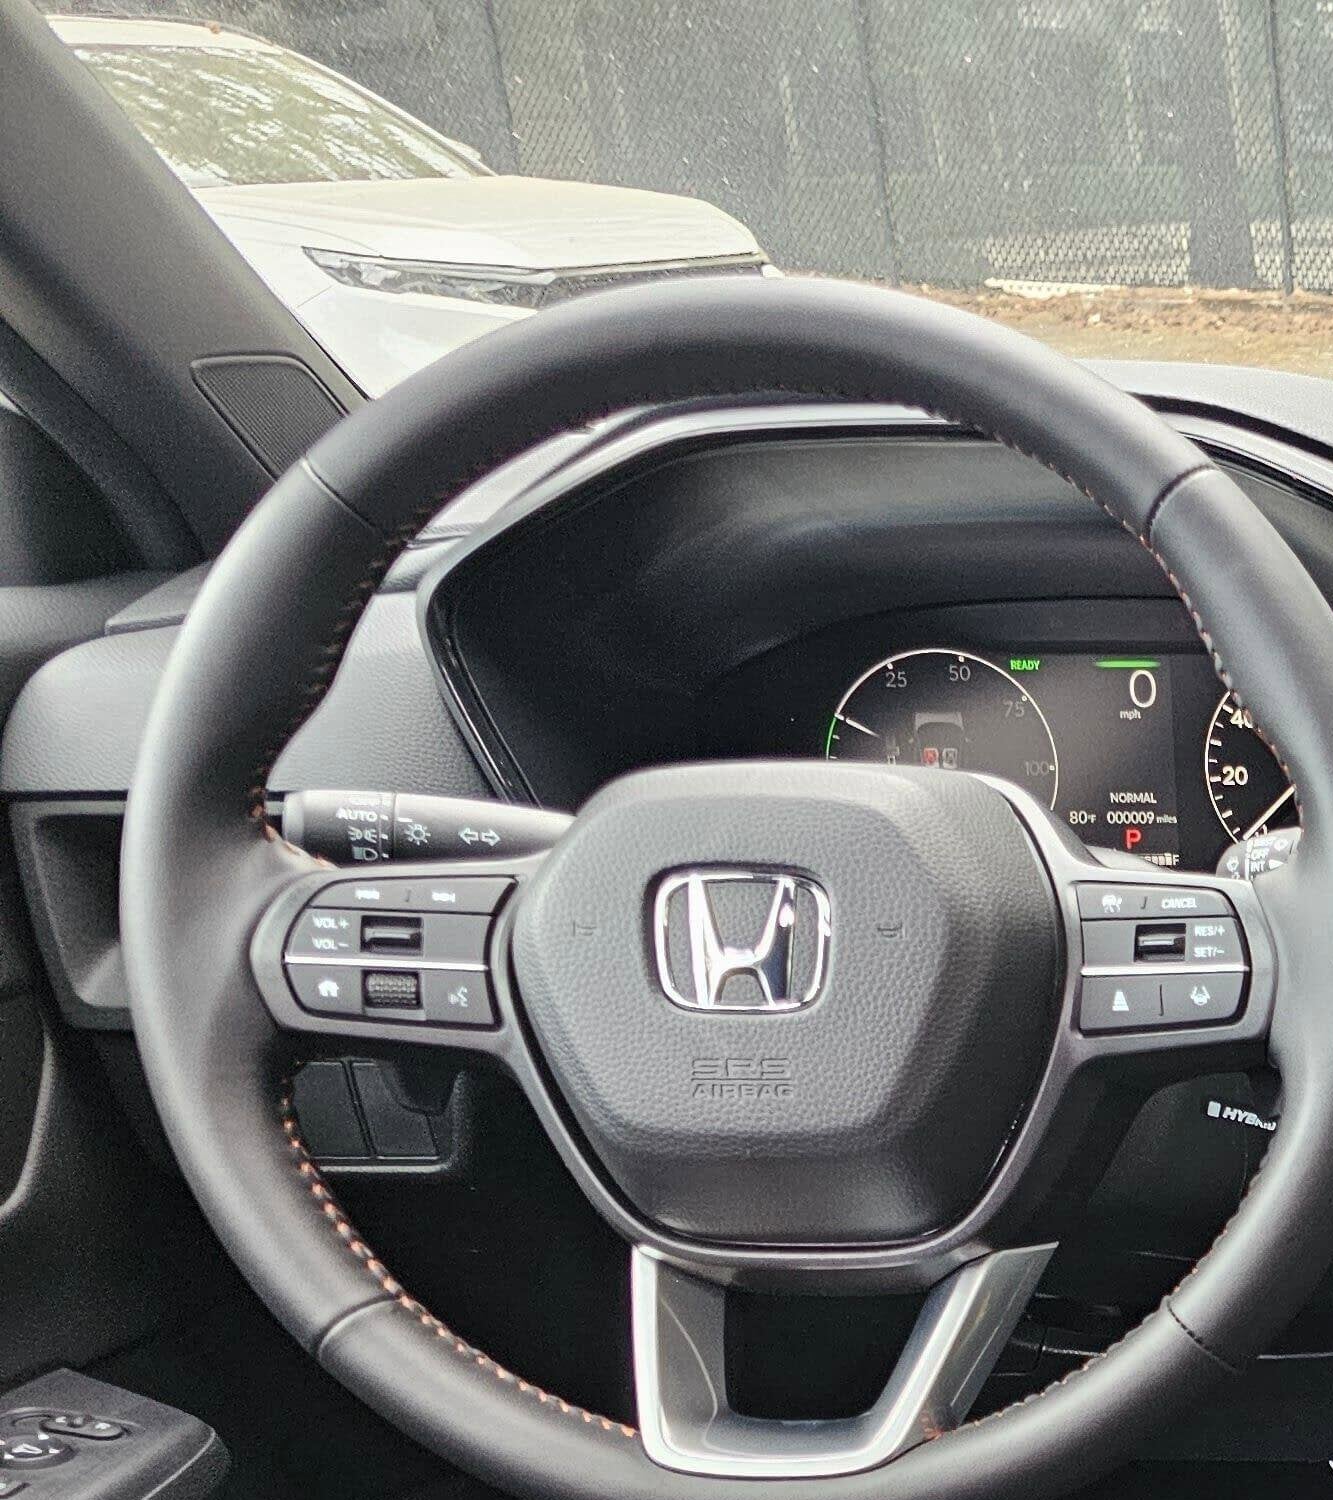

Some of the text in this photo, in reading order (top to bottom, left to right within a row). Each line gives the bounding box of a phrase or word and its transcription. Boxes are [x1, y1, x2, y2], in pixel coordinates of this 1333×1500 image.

[1010, 660, 1040, 671] READY
[885, 672, 907, 688] 25
[949, 666, 971, 682] 50
[1129, 669, 1157, 708] 0
[1004, 701, 1025, 718] 75
[1120, 709, 1141, 720] mph
[1025, 761, 1050, 775] 100
[1222, 766, 1249, 785] 20
[1110, 792, 1157, 804] NORMAL
[335, 809, 378, 822] AUTO
[1106, 811, 1155, 824] 000009
[1156, 814, 1178, 824] miles
[1125, 829, 1142, 850] P
[1161, 898, 1198, 910] CANCEL
[692, 1083, 793, 1100] AIRBAG
